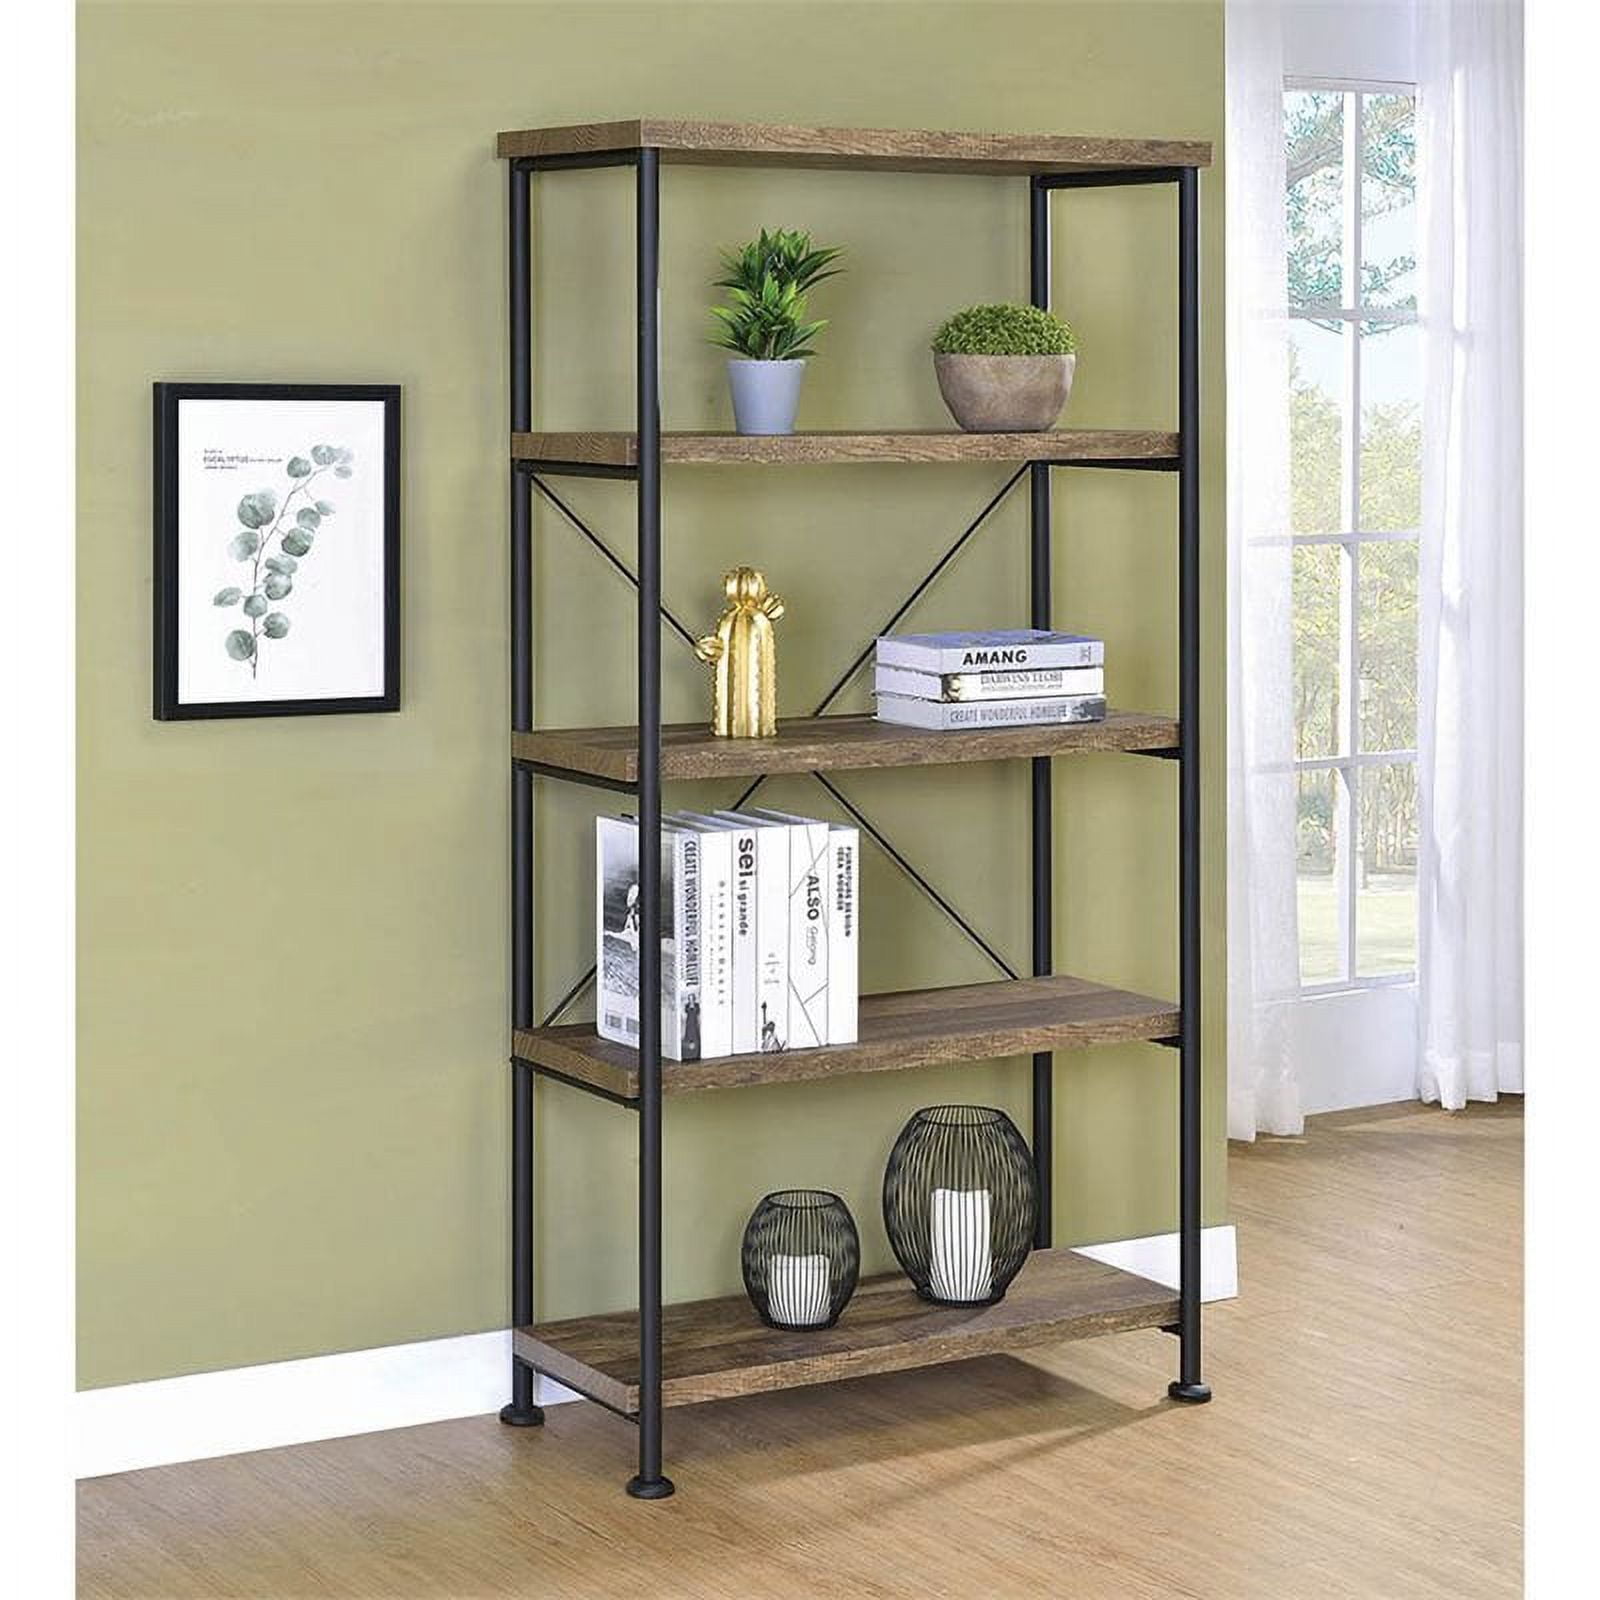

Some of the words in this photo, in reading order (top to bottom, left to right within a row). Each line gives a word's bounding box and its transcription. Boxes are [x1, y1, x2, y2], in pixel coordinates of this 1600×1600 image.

[962, 650, 1028, 666] AMANG
[684, 840, 697, 875] CREATE
[684, 877, 698, 937] WONDERFUL
[807, 875, 820, 921] ALSO
